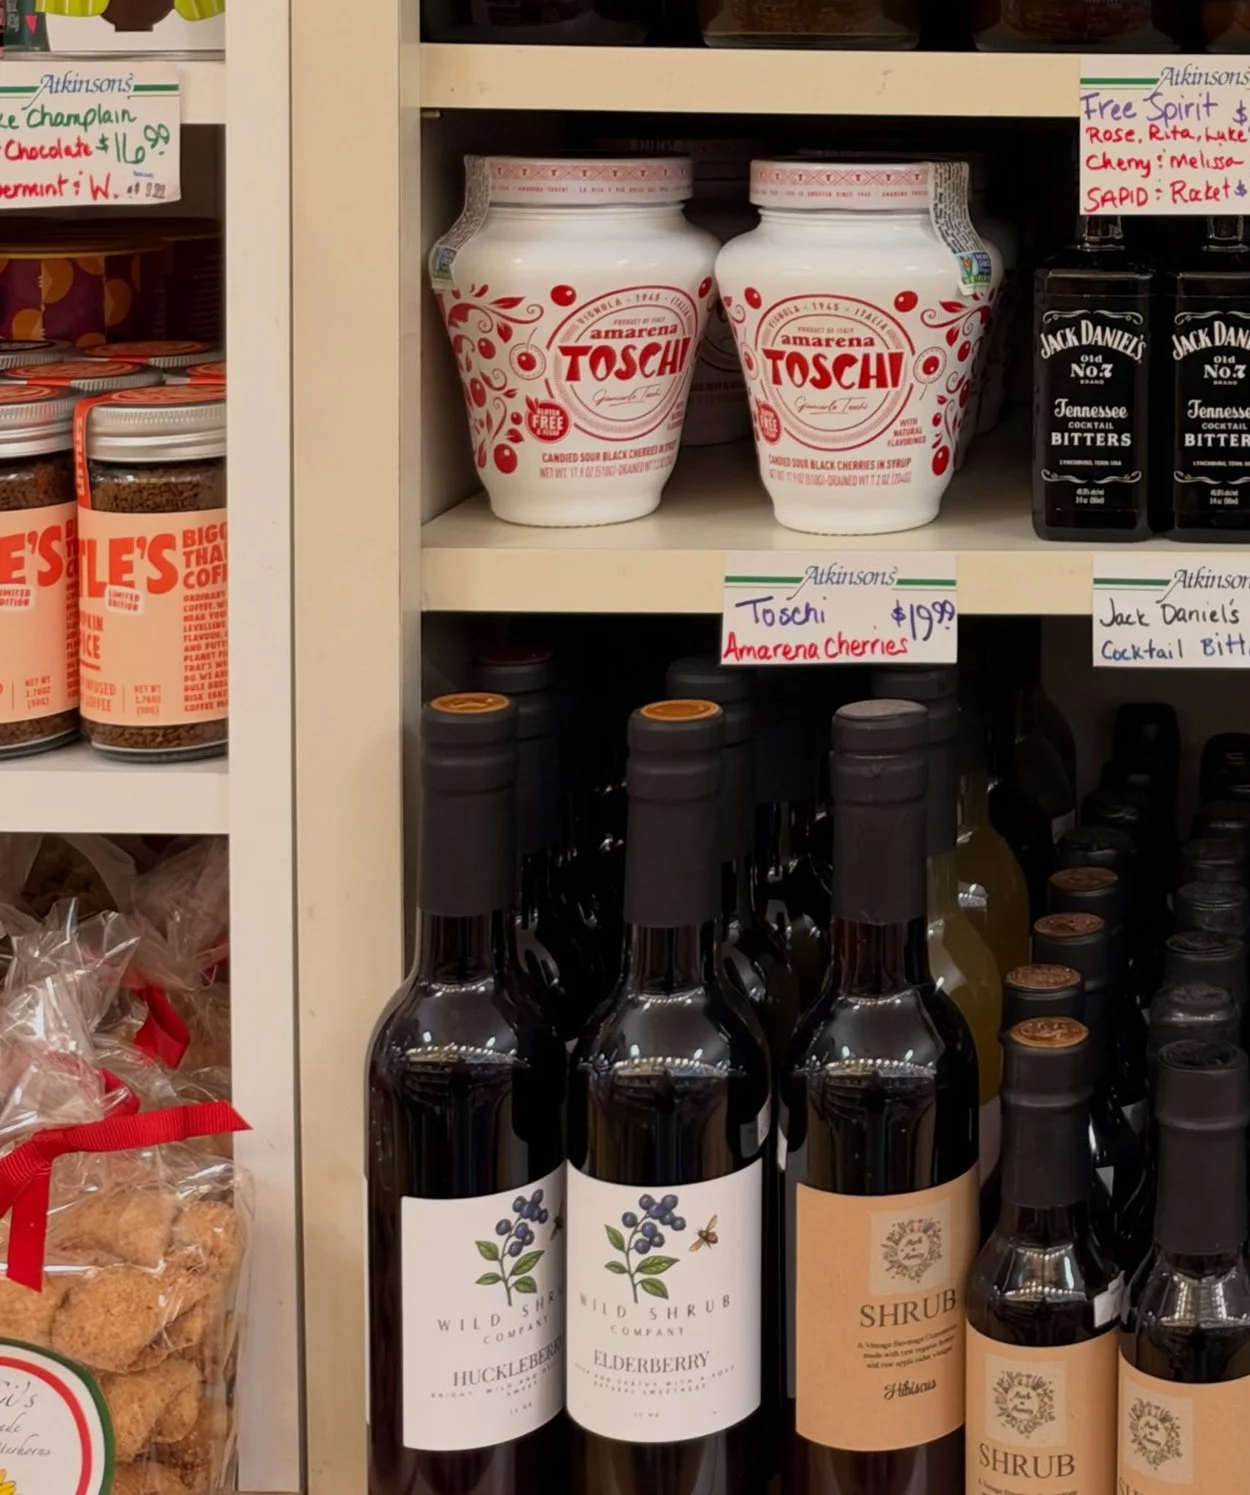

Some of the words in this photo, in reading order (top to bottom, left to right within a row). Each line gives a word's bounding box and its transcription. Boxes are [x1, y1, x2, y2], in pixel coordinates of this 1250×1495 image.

[1082, 93, 1136, 122] Free
[1145, 90, 1219, 122] Spirit
[4, 137, 93, 162] Chocolate
[1084, 188, 1149, 212] SAPID
[590, 322, 678, 340] amarena
[780, 334, 875, 348] amarena
[1040, 324, 1079, 360] JACK
[558, 338, 691, 382] TOSCHI
[762, 348, 904, 390] TOSCHI
[1070, 363, 1112, 380] No.7
[1054, 398, 1128, 420] Tennessee
[1051, 432, 1131, 447] BITTERS
[736, 597, 826, 628] Toschi
[723, 633, 821, 660] Amarena
[824, 634, 908, 657] Cherries
[1102, 636, 1184, 662] Cocktail
[859, 1289, 957, 1328] SHRUB
[593, 1349, 710, 1374] ELDERBERRY
[883, 1377, 937, 1401] Hibiscus
